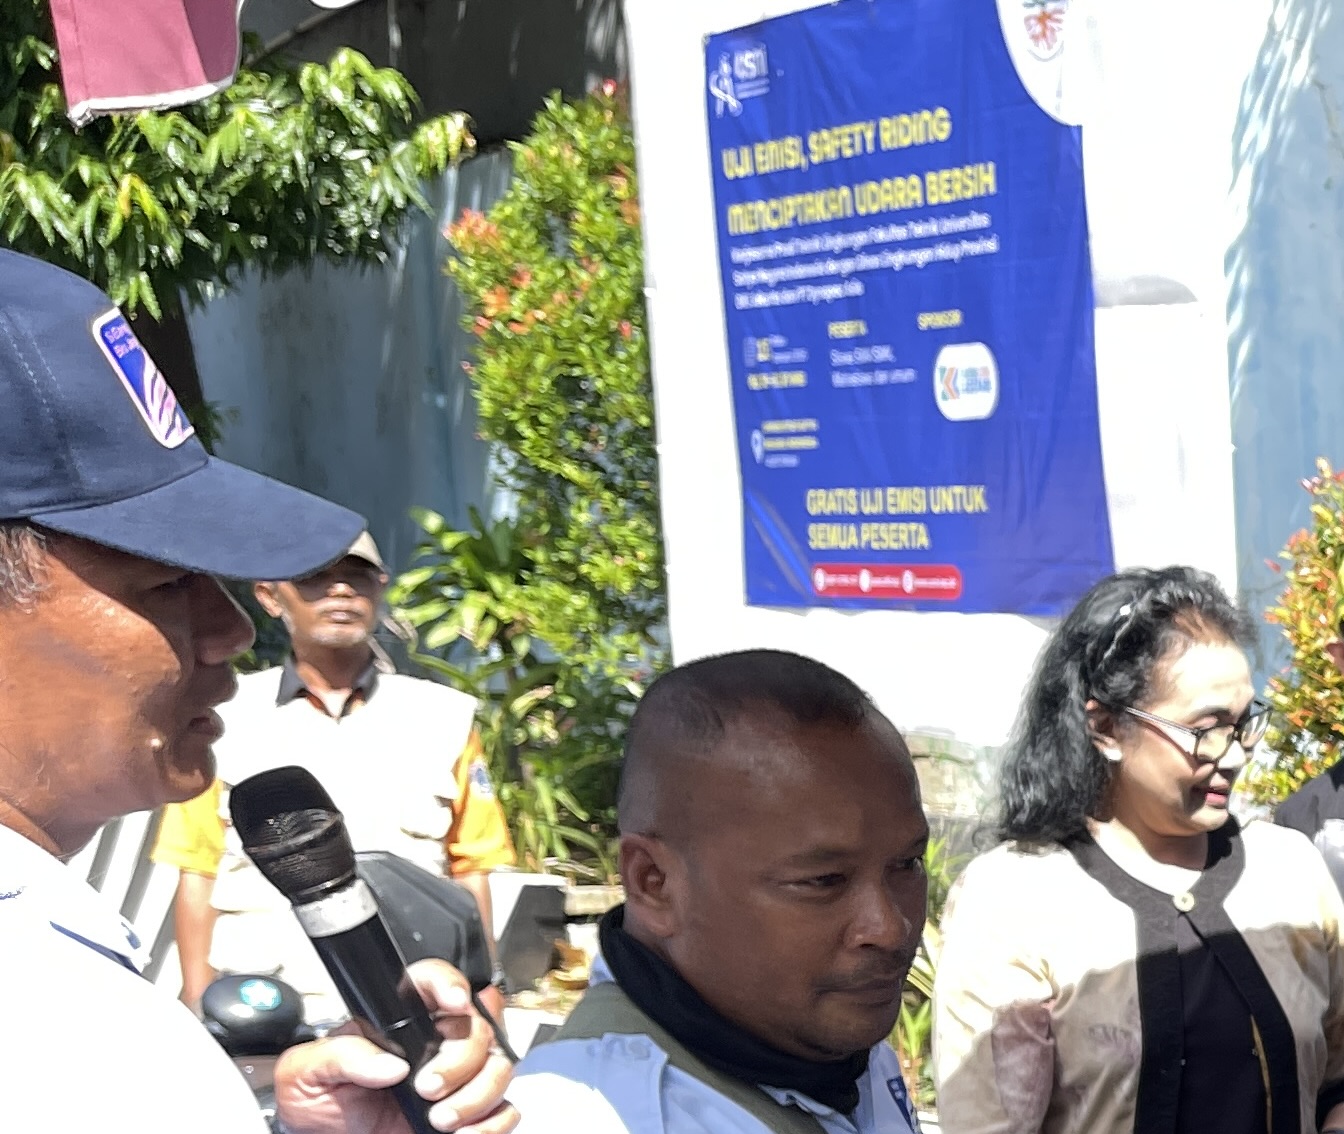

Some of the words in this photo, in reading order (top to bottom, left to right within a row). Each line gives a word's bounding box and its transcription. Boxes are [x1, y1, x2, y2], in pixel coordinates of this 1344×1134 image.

[722, 146, 754, 180] UJI
[808, 120, 876, 164] SAFETY
[878, 106, 952, 151] RIDING
[853, 174, 925, 217] UDARA
[925, 161, 997, 206] BERSIH
[806, 488, 858, 517] GRATIS
[859, 487, 884, 516] UJI
[886, 486, 928, 514] EMISI
[929, 484, 989, 515] UNTUK
[807, 522, 859, 551] SEMUA
[859, 522, 932, 551] PESERTA
